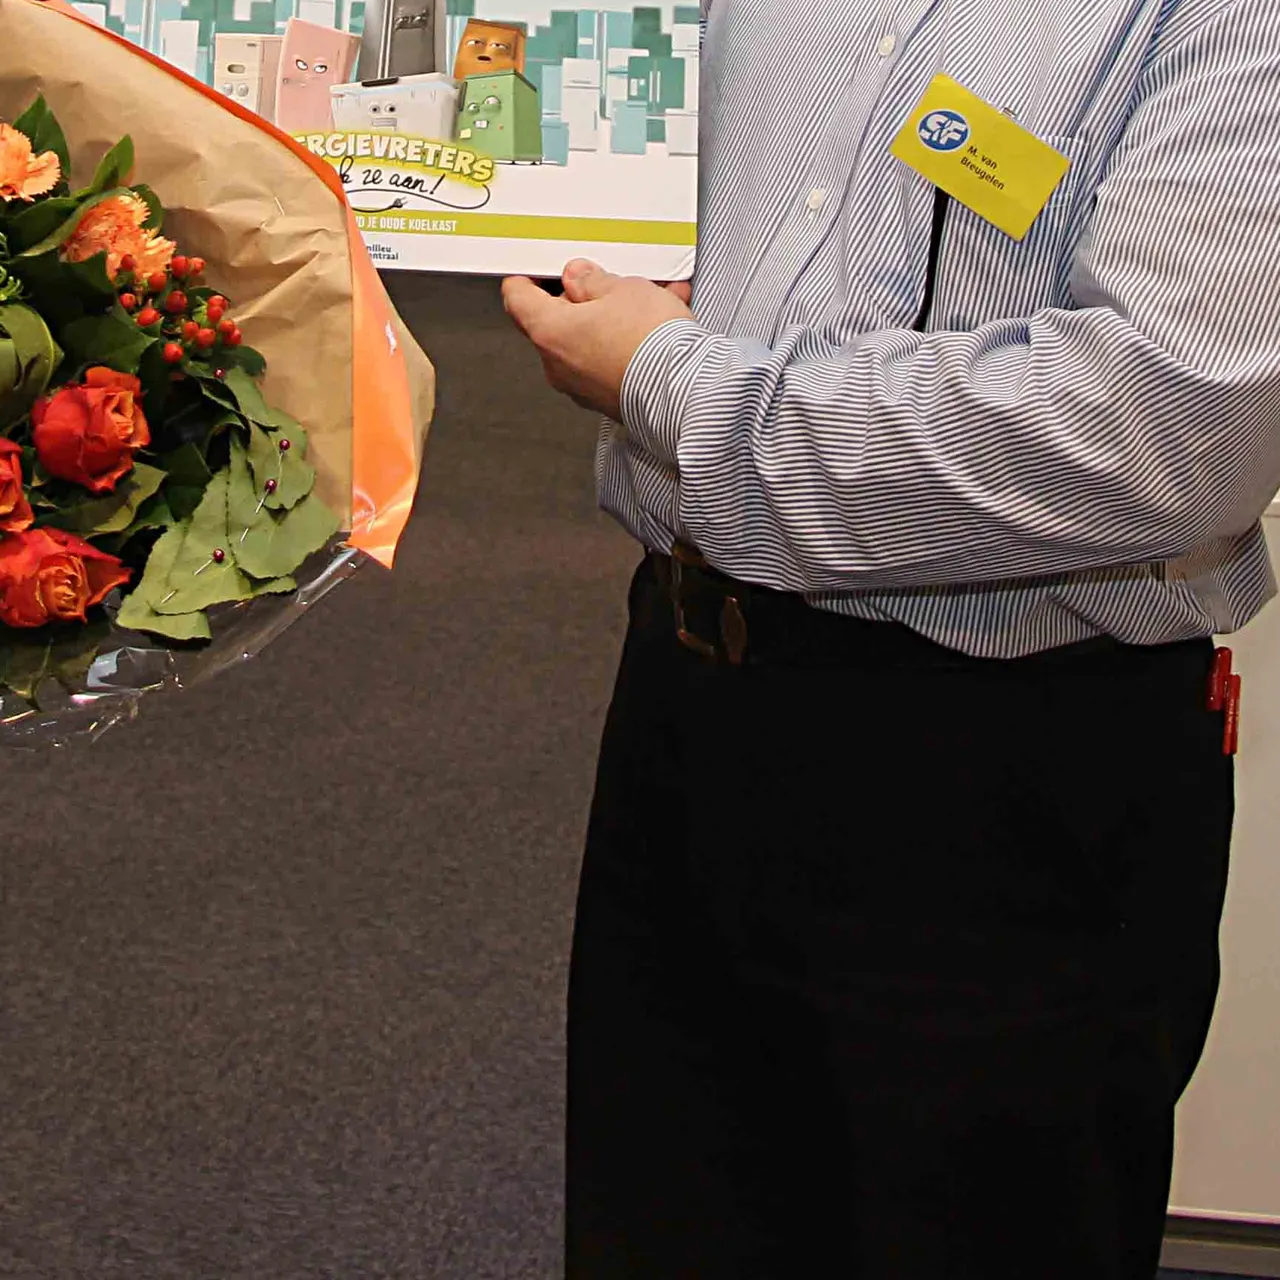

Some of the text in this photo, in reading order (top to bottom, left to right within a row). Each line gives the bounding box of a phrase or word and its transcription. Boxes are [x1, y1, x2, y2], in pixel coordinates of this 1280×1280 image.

[981, 153, 998, 170] van
[362, 169, 383, 186] ze
[389, 172, 446, 195] aan!
[959, 156, 1005, 191] Breugelen
[367, 217, 379, 230] JE
[380, 217, 407, 231] OUDE
[408, 218, 458, 233] KOELKAST
